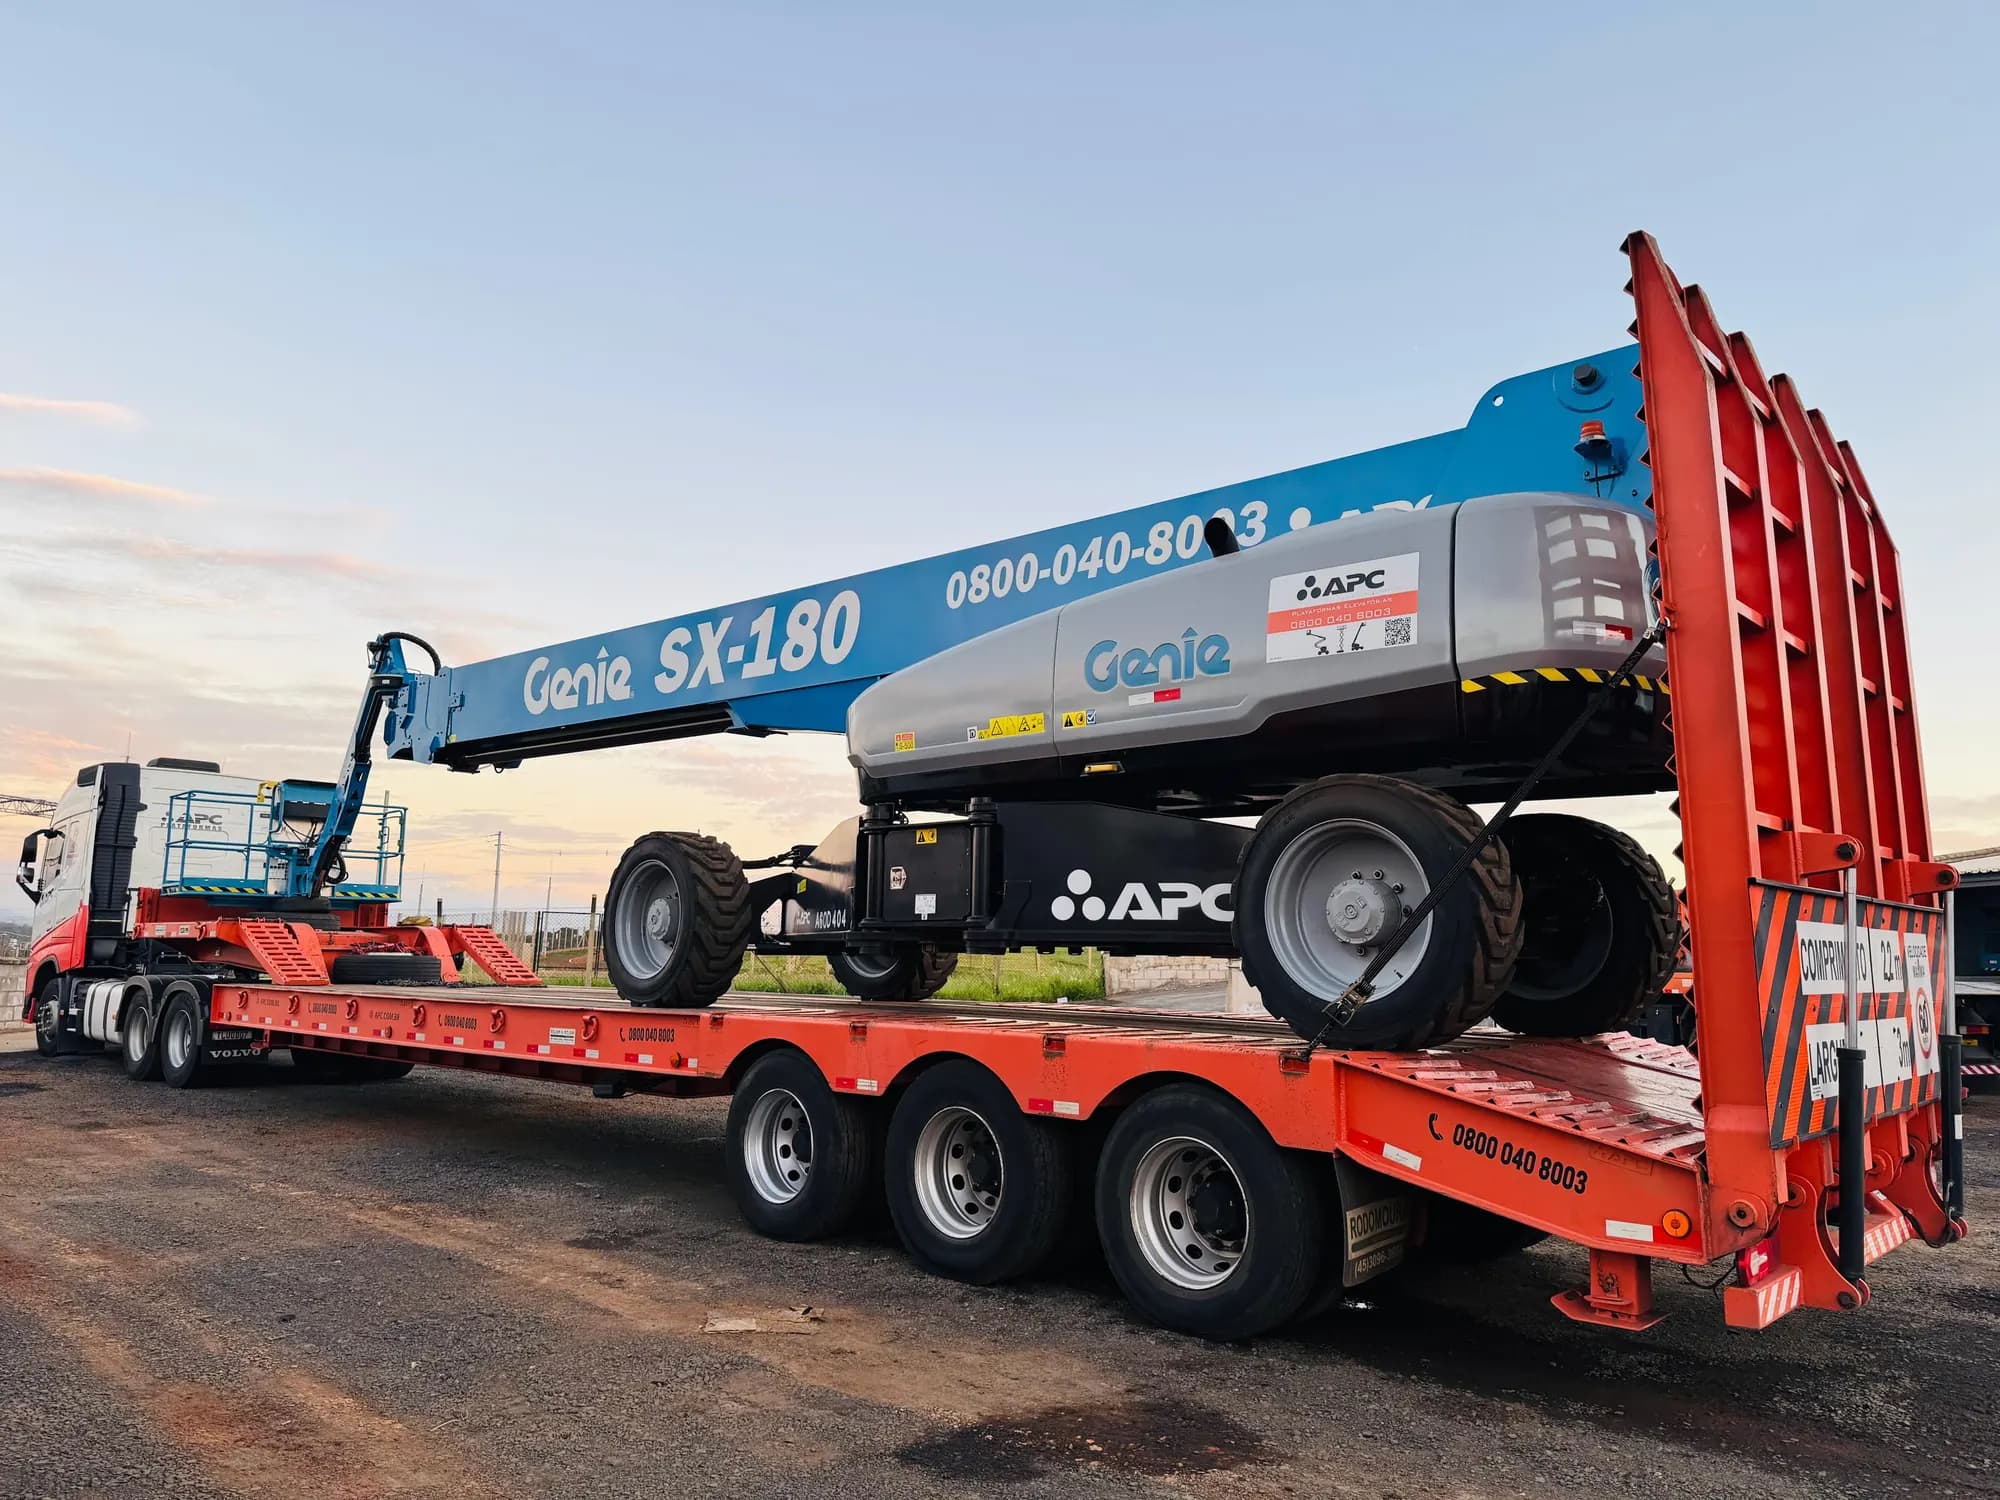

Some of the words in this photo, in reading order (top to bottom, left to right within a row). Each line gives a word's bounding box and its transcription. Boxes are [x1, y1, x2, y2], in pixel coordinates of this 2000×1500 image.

[1322, 569, 1385, 596] APC
[1290, 619, 1322, 630] 0800
[1327, 614, 1352, 624] 040
[1356, 607, 1391, 619] 8003
[523, 646, 632, 715] Genie
[654, 590, 861, 694] SX-180
[1083, 626, 1232, 693] Genie
[175, 812, 223, 825] APC
[1107, 882, 1235, 921] APC
[1800, 938, 1867, 981] COMPRIMTO
[628, 1027, 644, 1042] 0800
[645, 1028, 658, 1042] 040
[658, 1028, 675, 1043] 8003
[209, 1048, 261, 1059] VOLVO
[1452, 1123, 1498, 1160] 0800
[1500, 1142, 1536, 1174] 040
[1538, 1157, 1588, 1194] 8003
